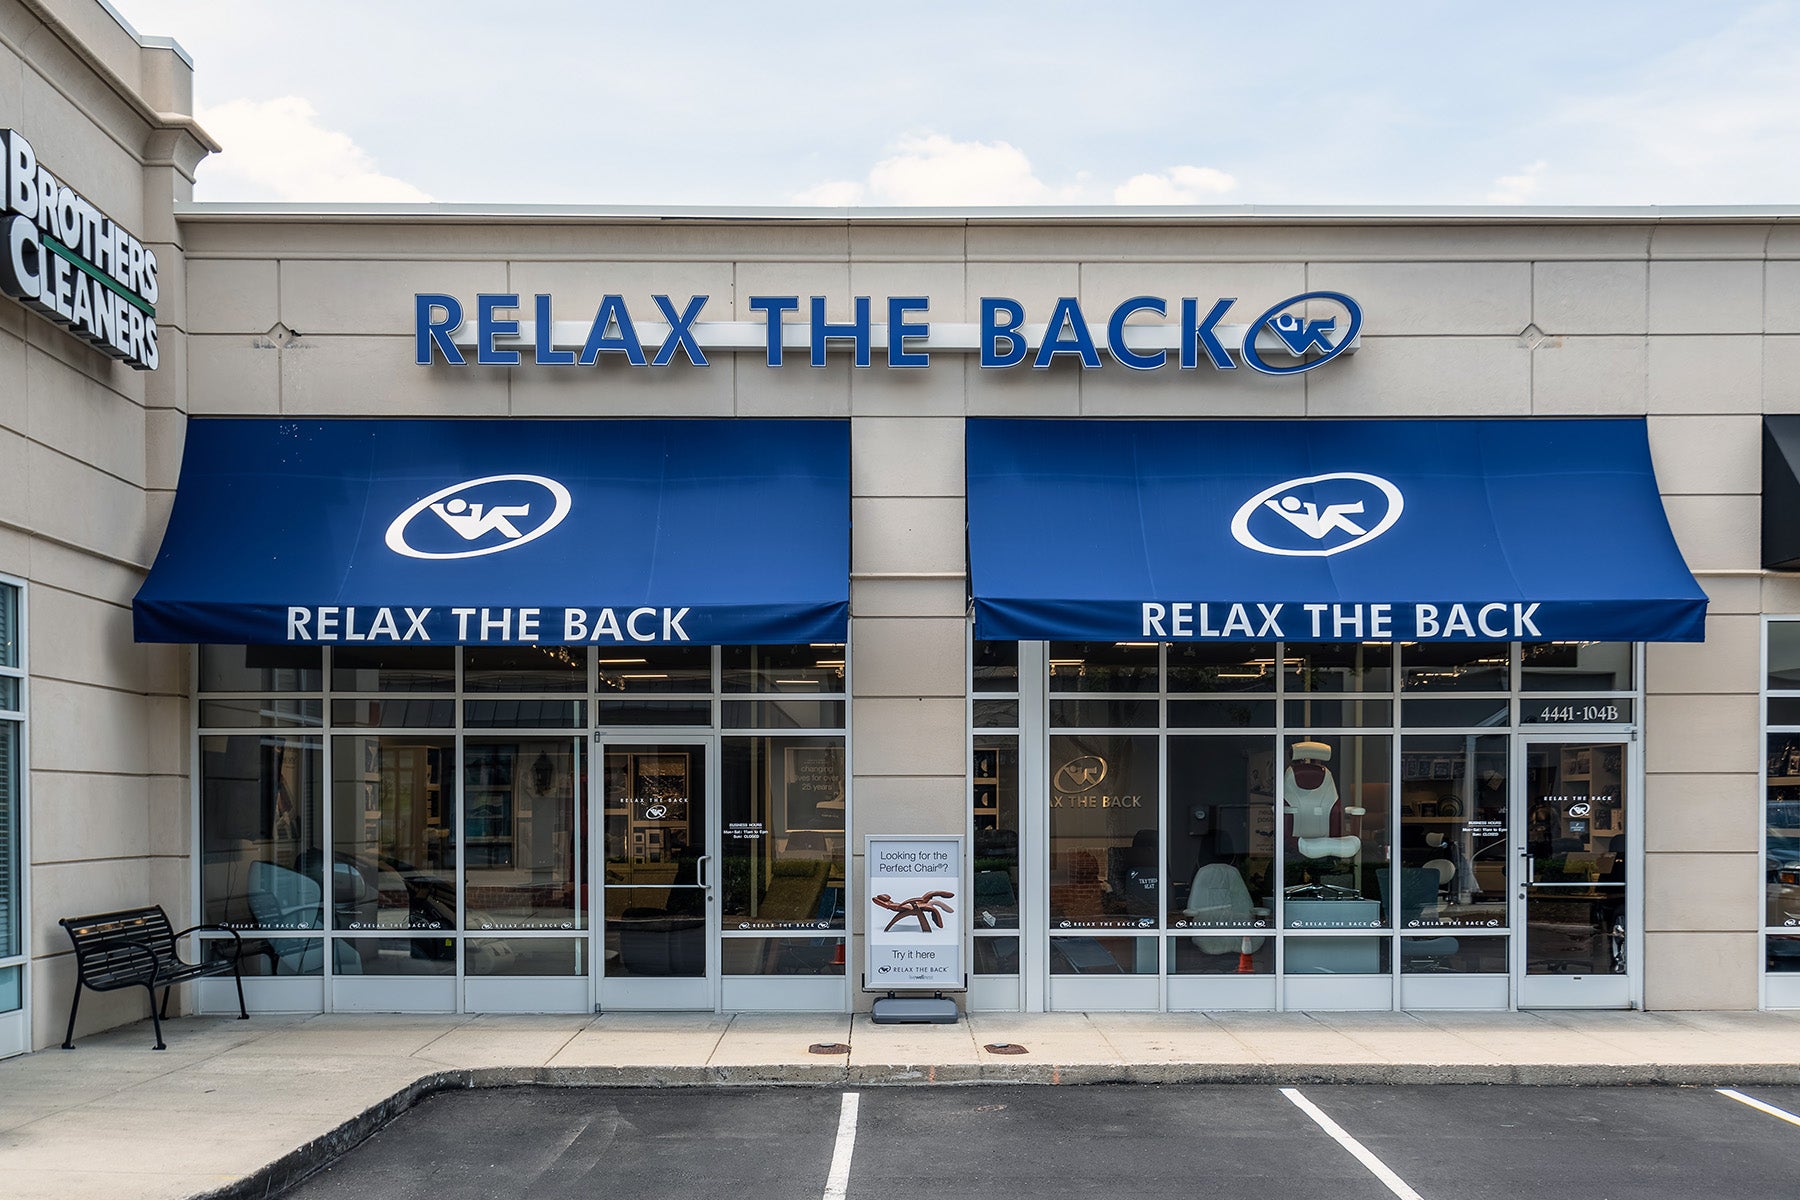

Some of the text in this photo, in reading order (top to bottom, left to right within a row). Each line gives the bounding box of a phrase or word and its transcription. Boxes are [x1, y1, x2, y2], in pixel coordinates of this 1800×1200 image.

[9, 128, 159, 304] BROTHERS
[8, 215, 159, 371] CLEANERS
[415, 294, 1238, 370] RELAX THE BACK
[286, 606, 691, 641] RELAX THE BACK
[1141, 602, 1542, 638] RELAX THE BACK
[1540, 706, 1618, 721] 4441-104B
[1068, 795, 1097, 808] THE
[1102, 795, 1142, 808] BACK
[879, 863, 912, 872] Perfect
[880, 851, 948, 862] Looking for the
[892, 950, 936, 960] Try it here
